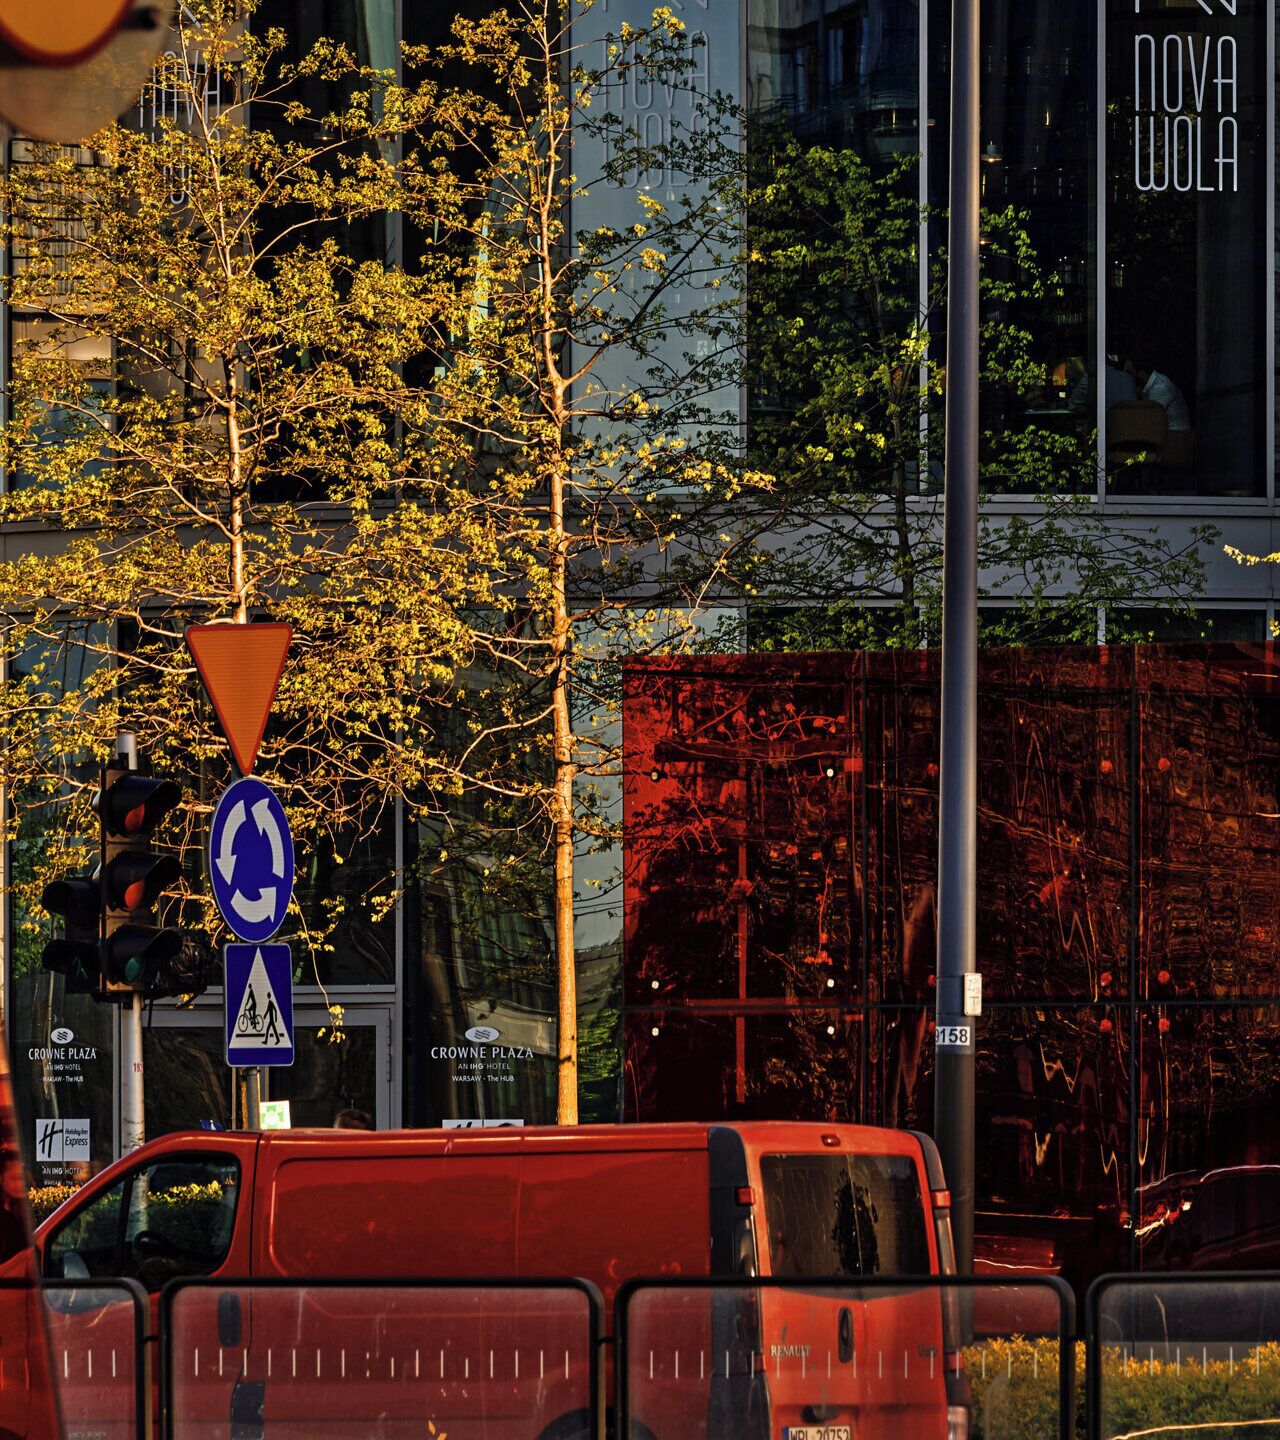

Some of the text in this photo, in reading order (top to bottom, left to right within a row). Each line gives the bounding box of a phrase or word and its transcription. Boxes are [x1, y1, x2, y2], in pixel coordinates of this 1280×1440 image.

[1134, 33, 1238, 114] NOVA
[1134, 115, 1238, 193] WOLA
[28, 1048, 97, 1060] CROWNE PLAZA
[431, 1046, 534, 1059] CROWNE PLAZA
[65, 1136, 88, 1148] Express
[770, 1344, 811, 1357] RENAULT
